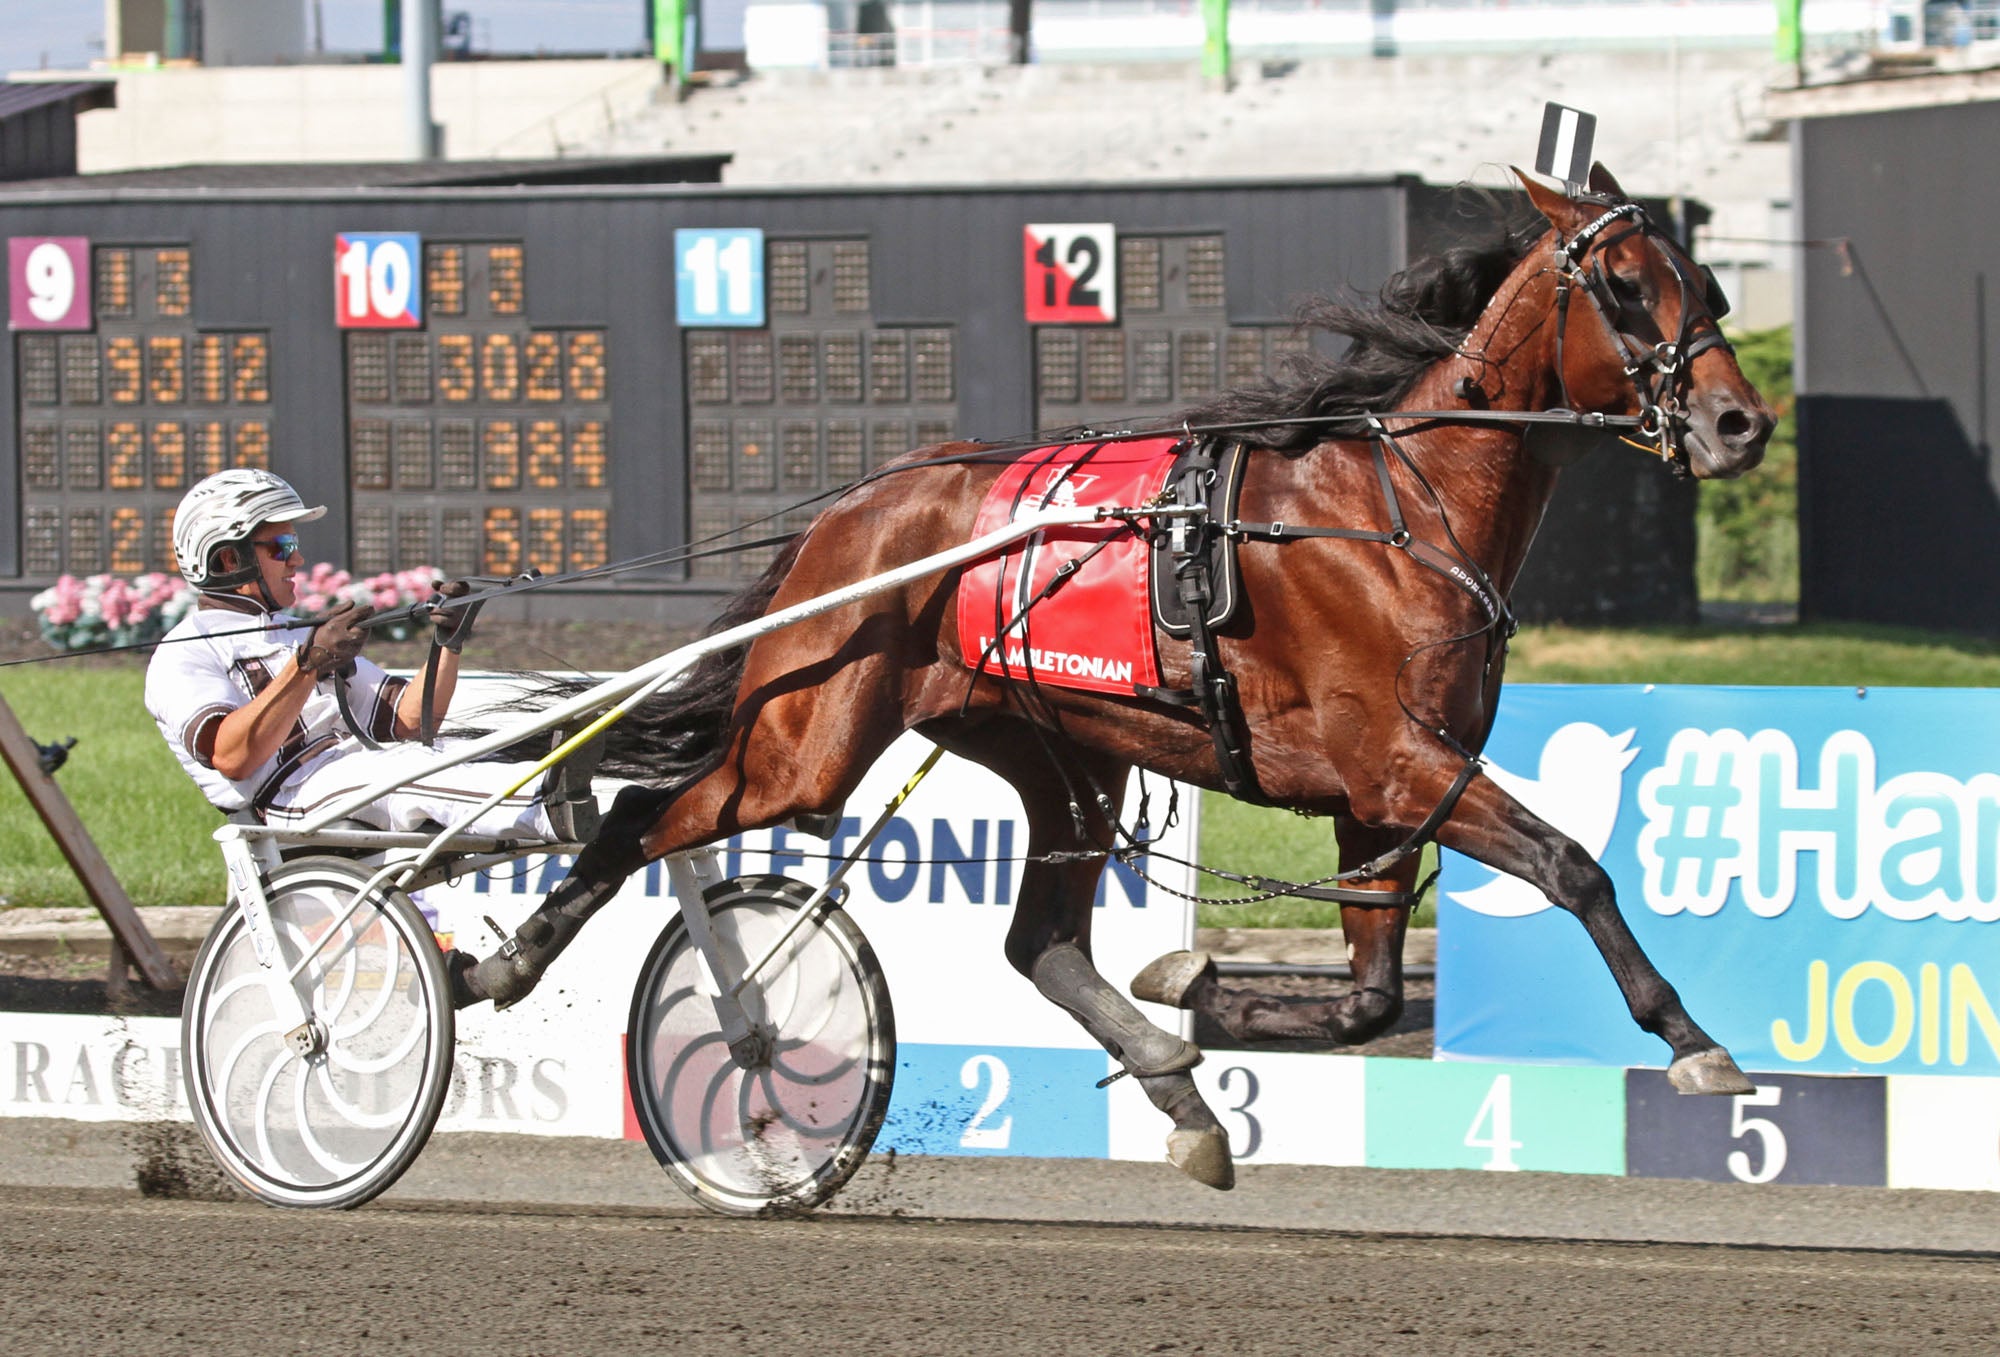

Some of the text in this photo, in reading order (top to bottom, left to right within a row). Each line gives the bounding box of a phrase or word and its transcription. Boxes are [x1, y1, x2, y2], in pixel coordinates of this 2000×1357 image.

[1583, 204, 1629, 238] ROYALTY
[25, 242, 75, 322] 9
[340, 240, 412, 319] 10
[684, 236, 752, 315] 11
[1035, 235, 1101, 307] 12
[107, 337, 268, 401] 9312
[437, 332, 606, 401] 3028
[959, 1054, 1013, 1149] 2
[1218, 1065, 1263, 1160] 3
[1463, 1074, 1523, 1171] 4
[1726, 1085, 1788, 1184] 5
